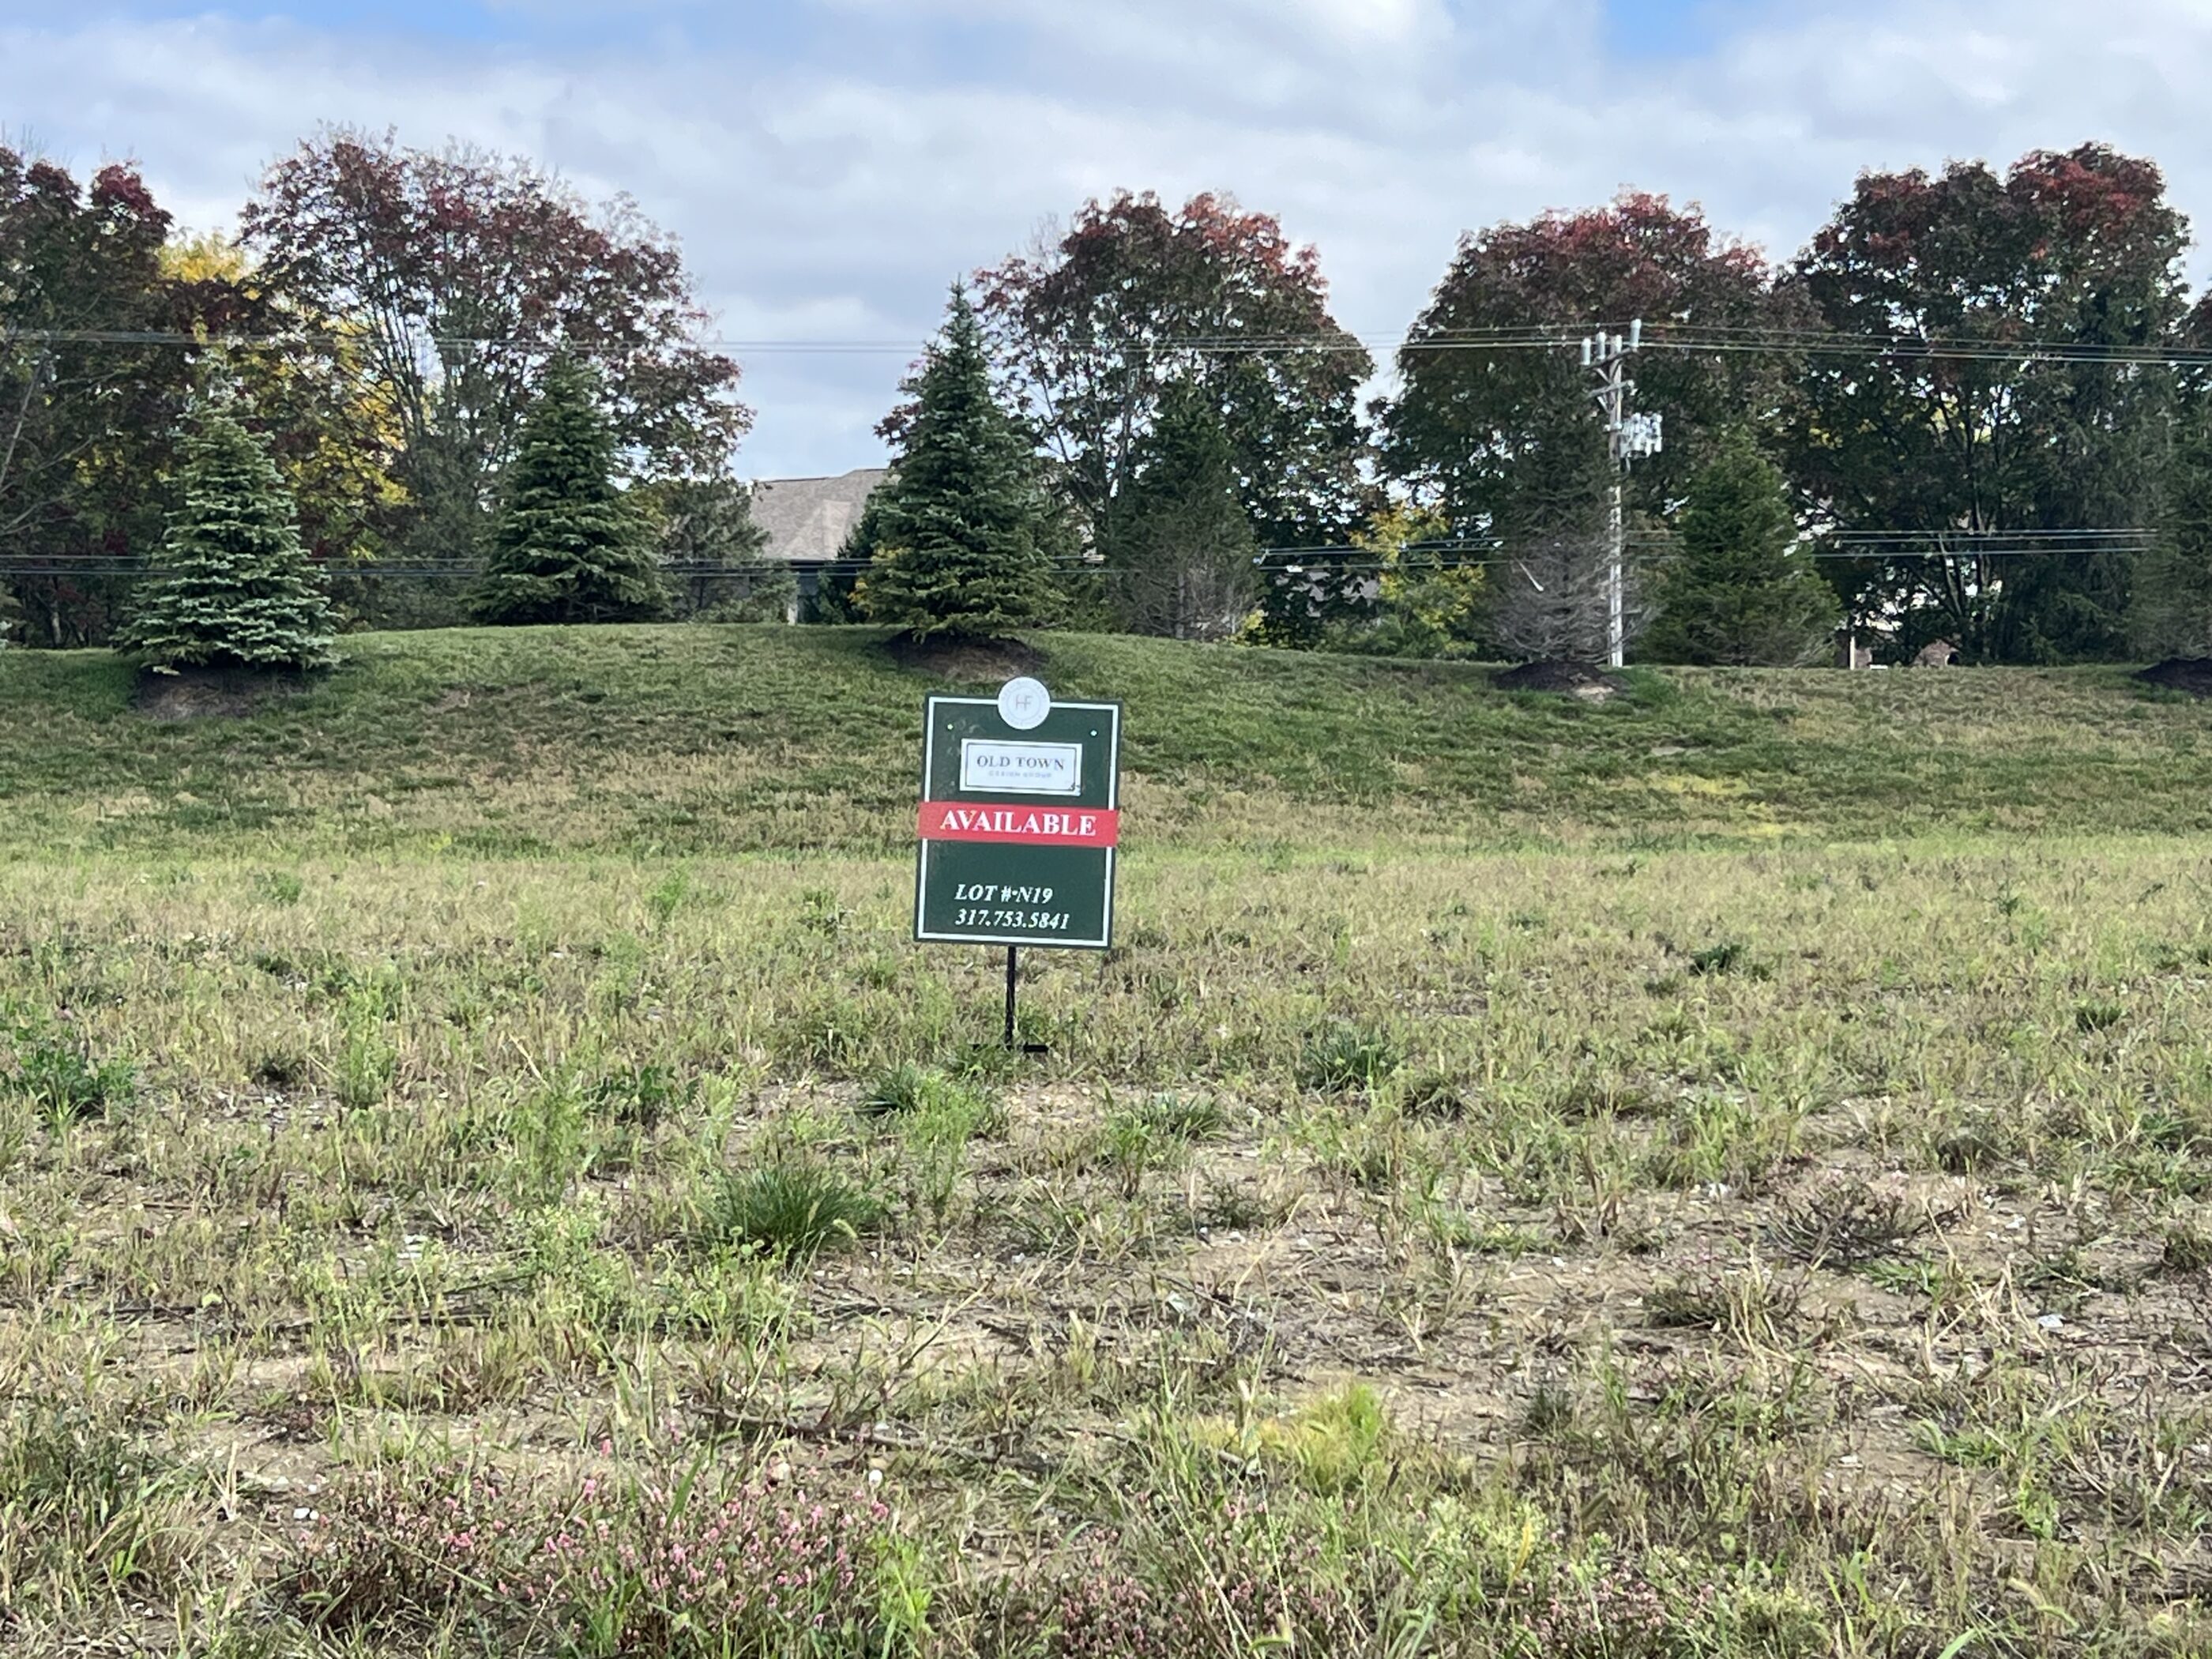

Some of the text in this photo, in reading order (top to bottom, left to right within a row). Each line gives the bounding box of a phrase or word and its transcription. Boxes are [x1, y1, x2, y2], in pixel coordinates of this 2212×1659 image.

[976, 755, 1065, 771] OLD TOWN
[939, 809, 1097, 837] AVAILABLE
[954, 883, 999, 901] LOT
[954, 908, 1070, 930] 317.753.5841
